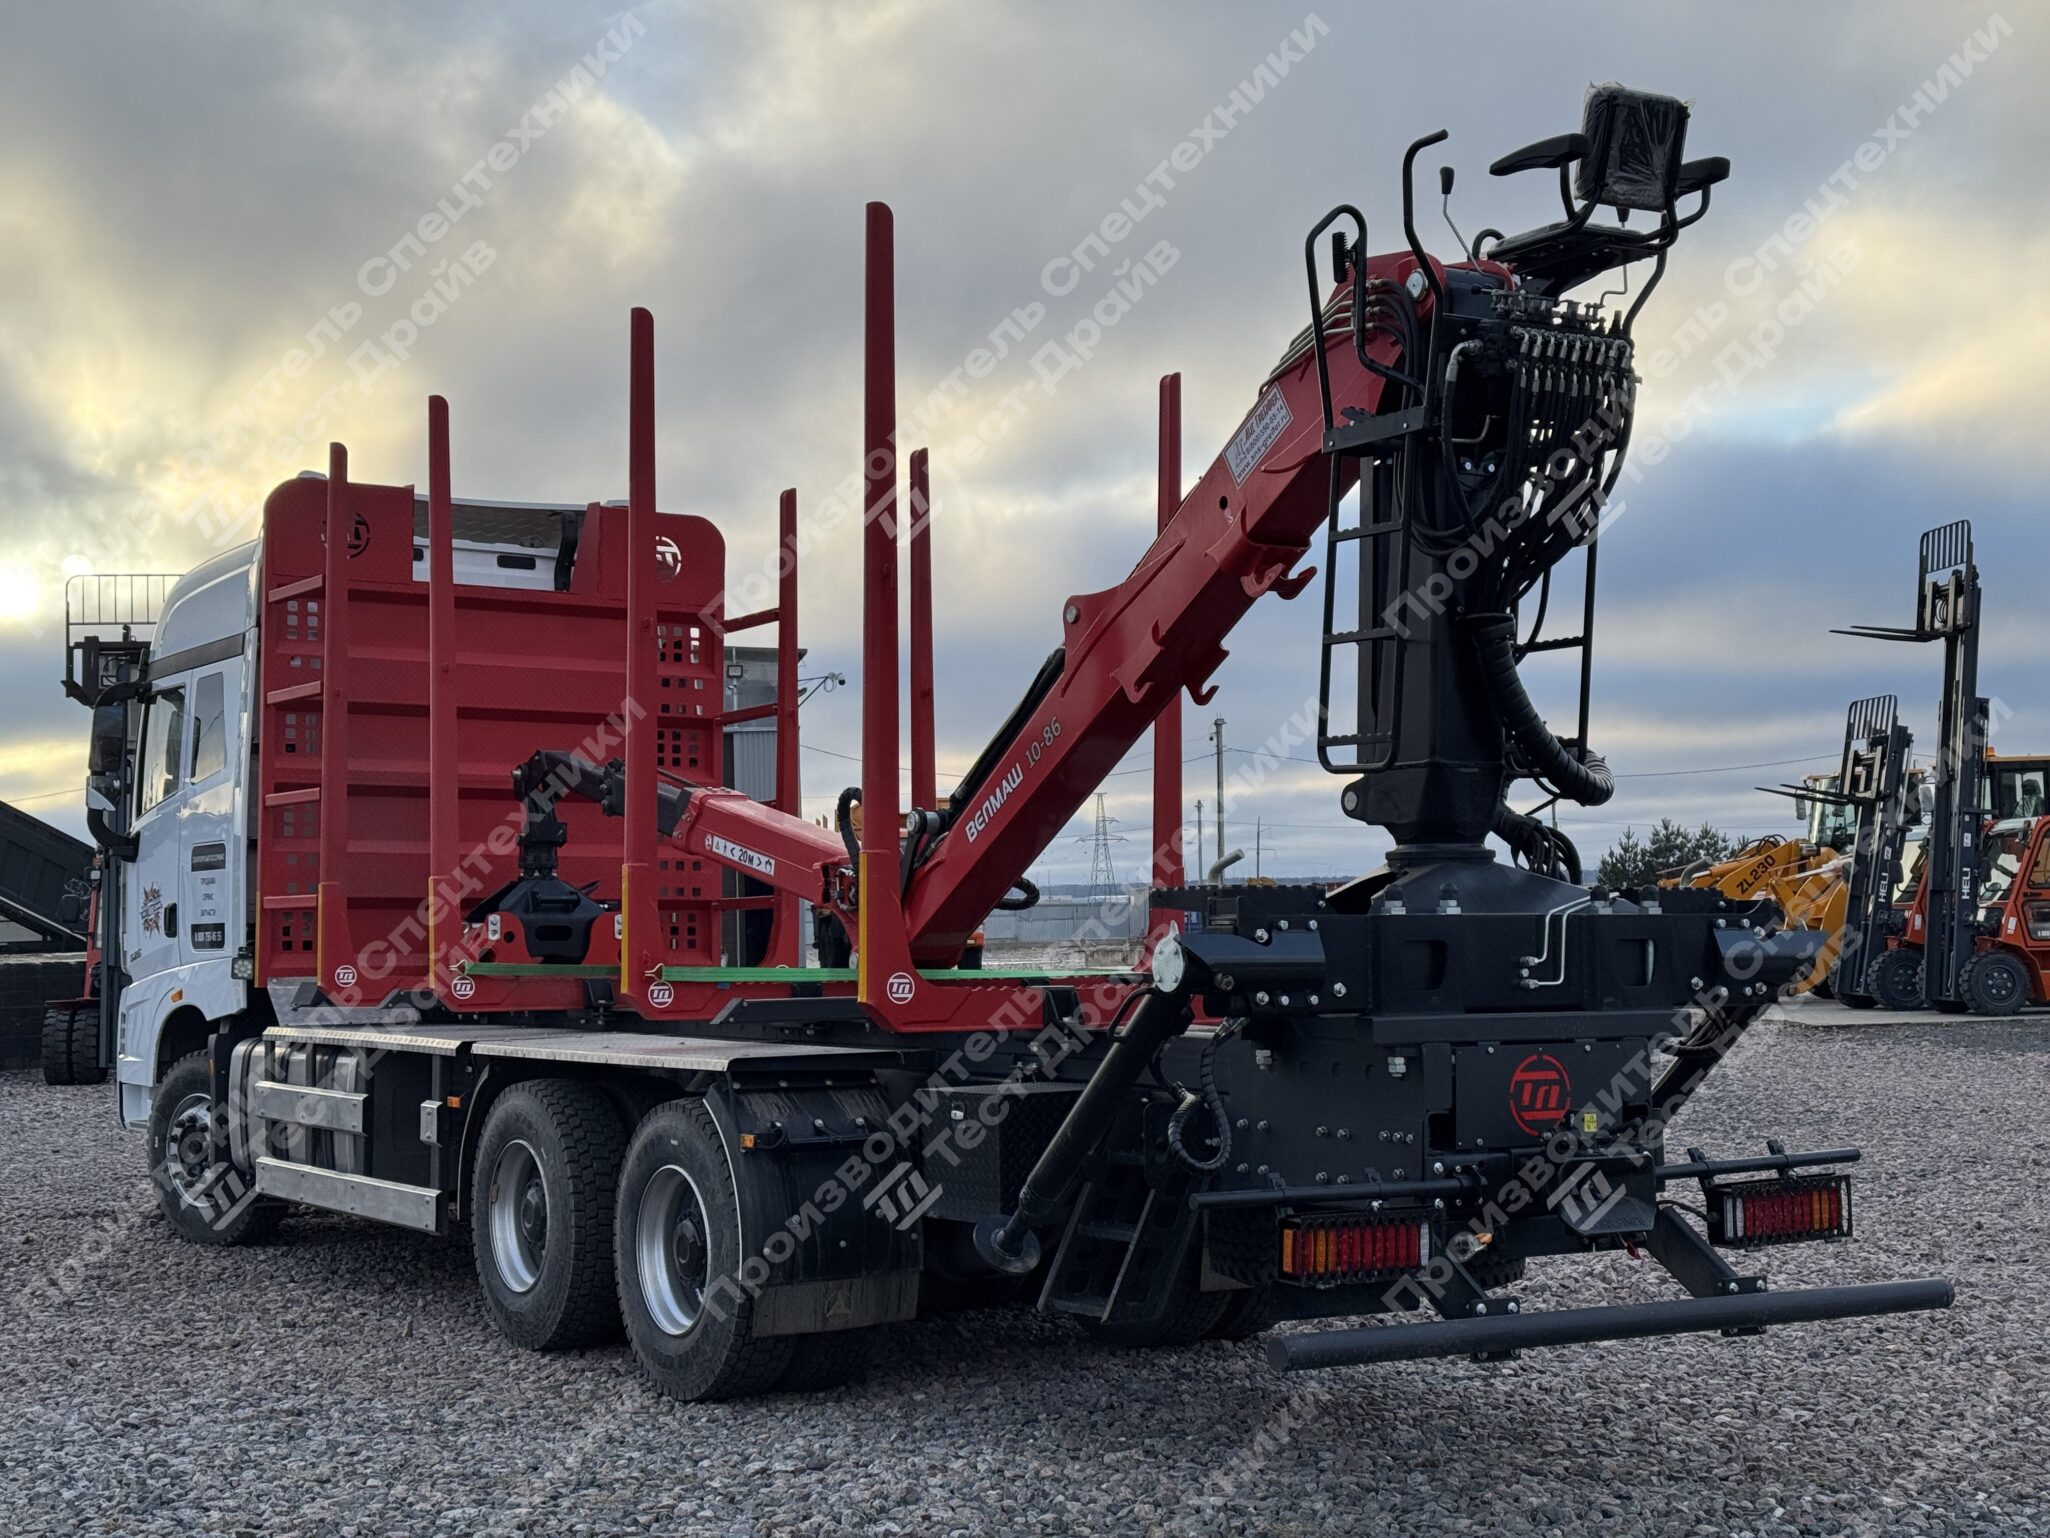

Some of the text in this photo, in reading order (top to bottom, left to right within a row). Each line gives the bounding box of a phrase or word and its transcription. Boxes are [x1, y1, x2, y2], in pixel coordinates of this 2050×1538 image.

[1025, 716, 1061, 769] 10-86
[1736, 854, 1776, 895] ZL230
[1878, 872, 1889, 902] HELI
[1962, 867, 1971, 899] HELI
